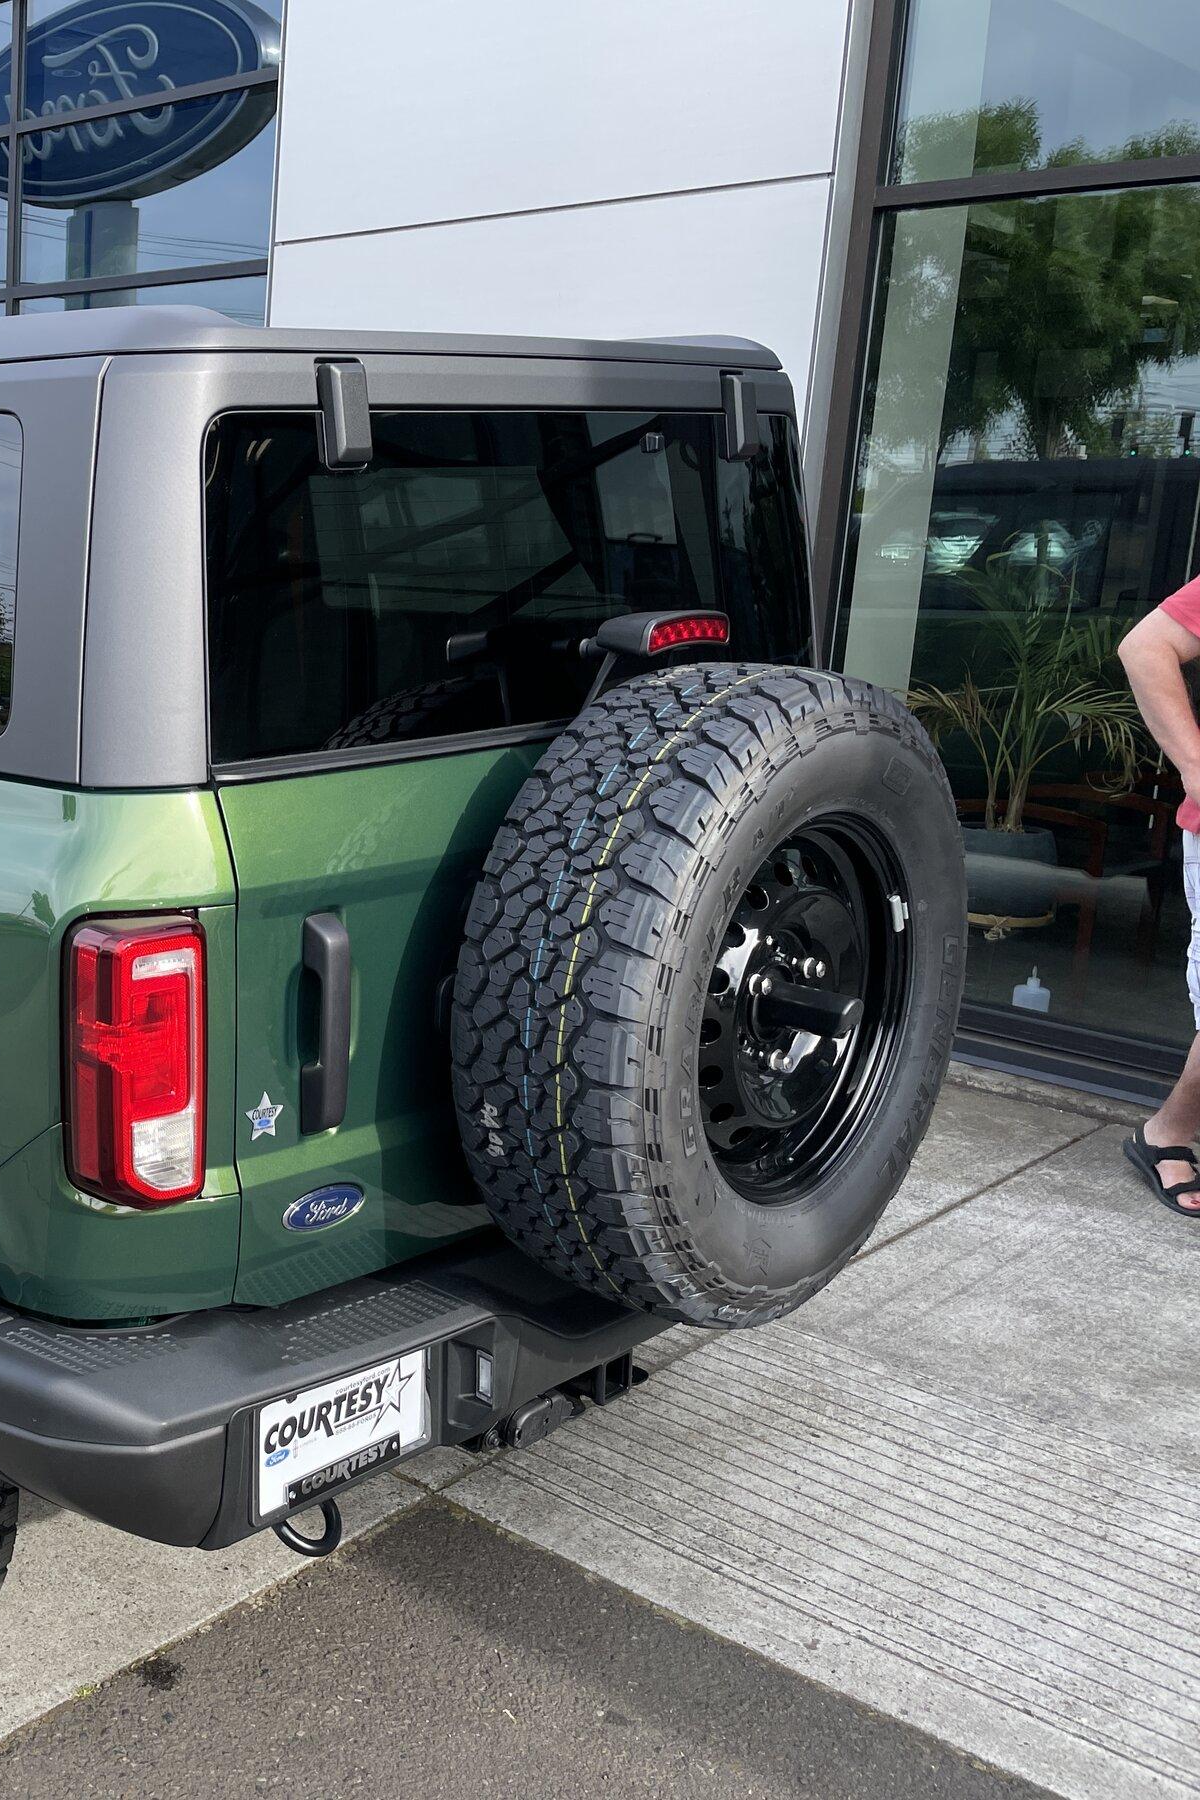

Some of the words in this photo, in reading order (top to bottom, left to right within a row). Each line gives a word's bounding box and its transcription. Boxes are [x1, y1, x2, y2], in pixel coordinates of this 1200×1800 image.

[252, 1106, 278, 1121] COURTESY
[304, 1197, 348, 1225] Ford
[335, 1366, 391, 1395] courtesyford.com
[264, 1373, 390, 1454] COURTESY
[301, 1440, 390, 1494] COURTESY
